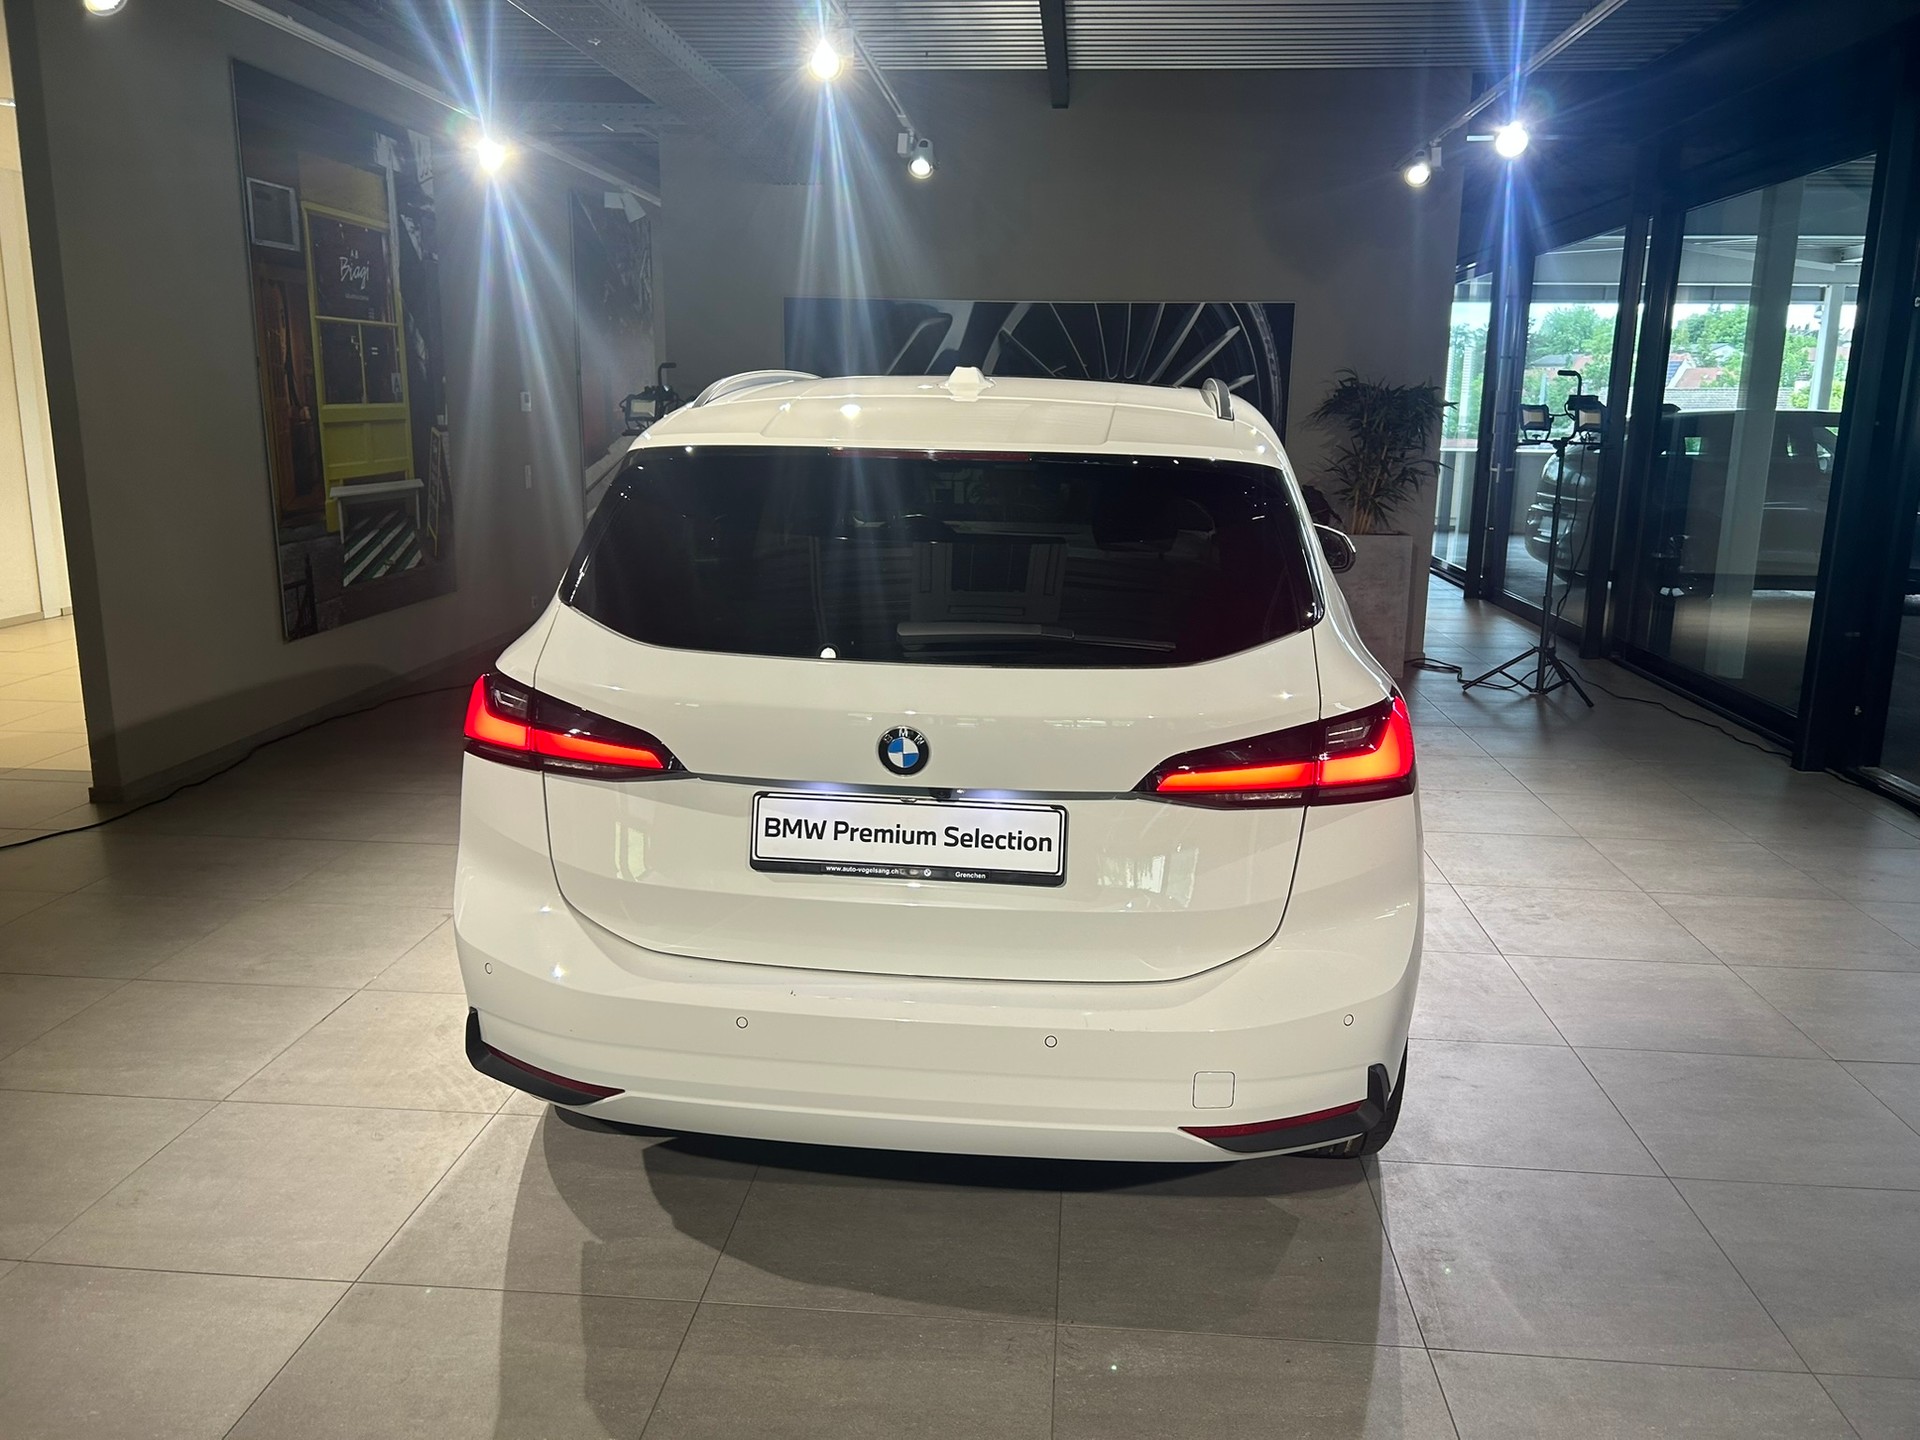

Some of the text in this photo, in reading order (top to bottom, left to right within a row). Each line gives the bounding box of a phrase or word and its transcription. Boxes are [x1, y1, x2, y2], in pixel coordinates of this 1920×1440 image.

[764, 817, 1052, 852] BMW Premium Selection
[825, 865, 899, 875] www.auto-vogelsang.ch
[955, 871, 986, 879] Grenchen
